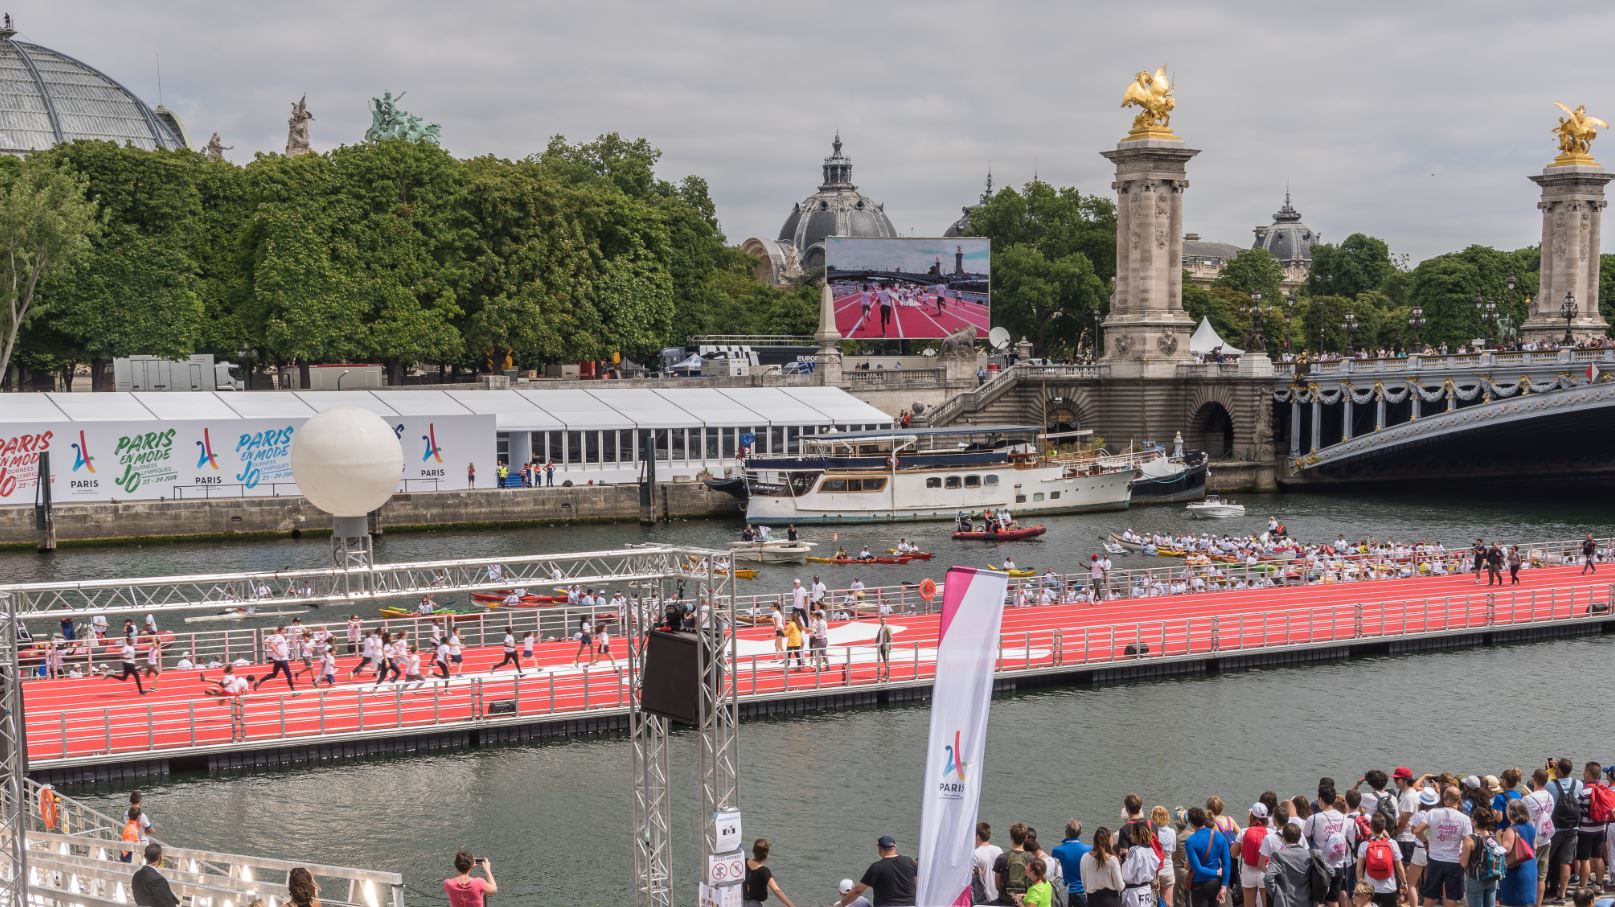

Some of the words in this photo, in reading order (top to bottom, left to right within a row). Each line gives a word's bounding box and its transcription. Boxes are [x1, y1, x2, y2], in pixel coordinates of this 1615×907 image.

[114, 428, 176, 456] PARIS
[236, 426, 294, 452] PARIS
[9, 452, 40, 467] MOD
[120, 453, 135, 465] EN
[134, 447, 172, 464] MODE
[241, 450, 255, 461] EN
[254, 445, 290, 461] MODE
[420, 469, 446, 477] PARIS
[70, 480, 99, 488] PARIS
[195, 477, 222, 485] PARIS
[939, 783, 965, 792] PARIS
